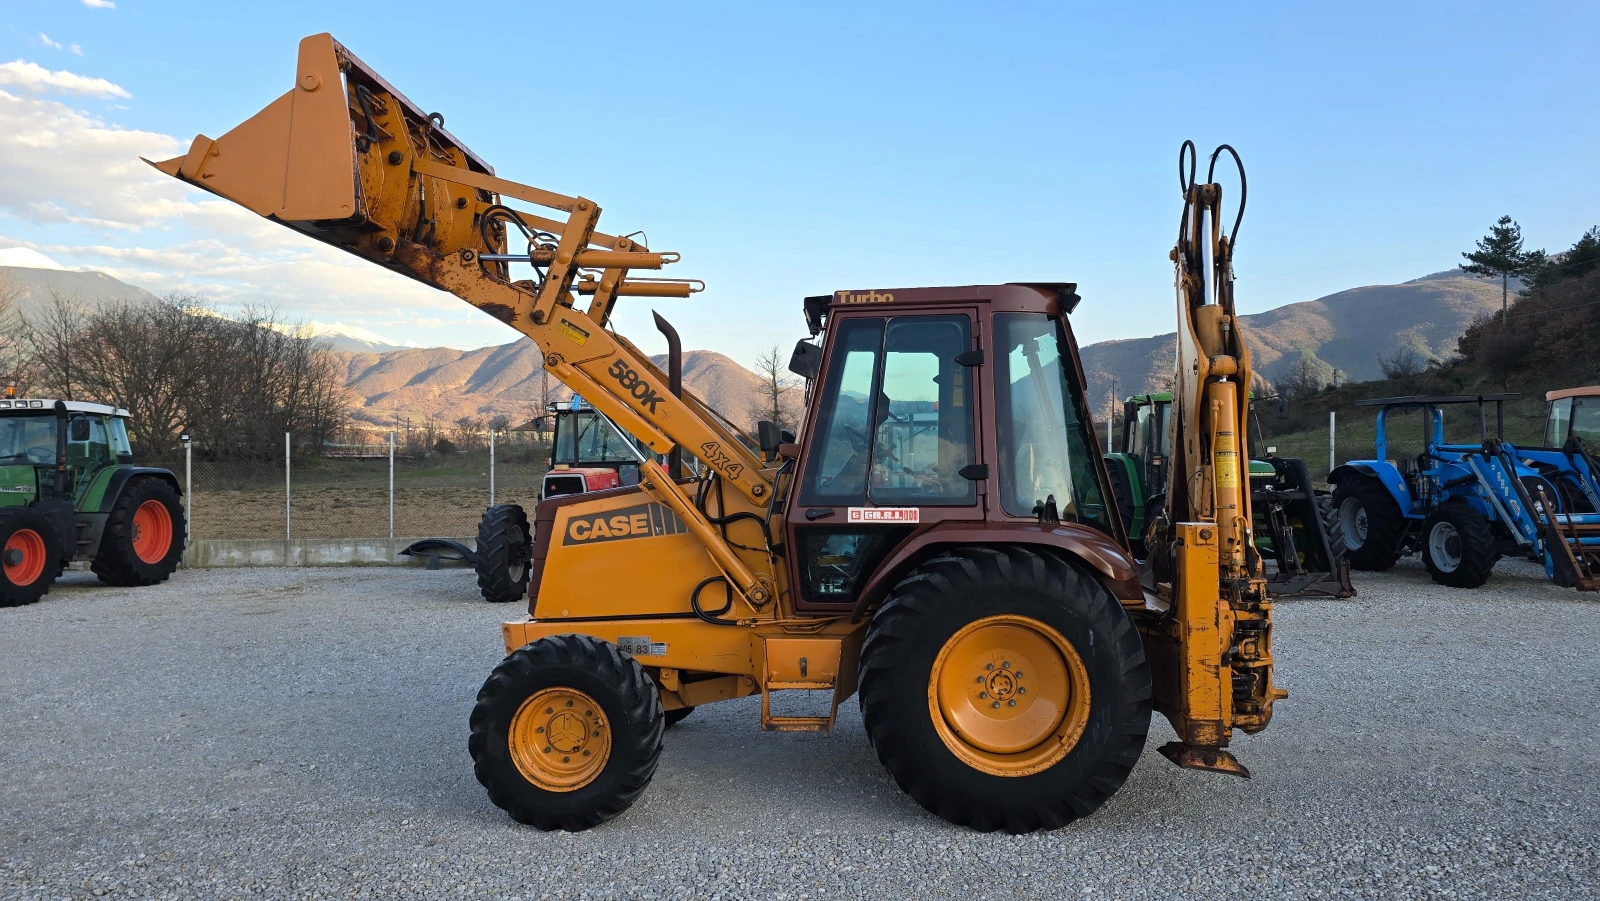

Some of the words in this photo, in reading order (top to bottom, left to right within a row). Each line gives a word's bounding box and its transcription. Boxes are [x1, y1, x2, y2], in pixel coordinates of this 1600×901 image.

[836, 290, 894, 304] Turbo
[608, 358, 667, 416] 580K
[569, 513, 649, 541] CASE
[636, 644, 648, 654] 83
